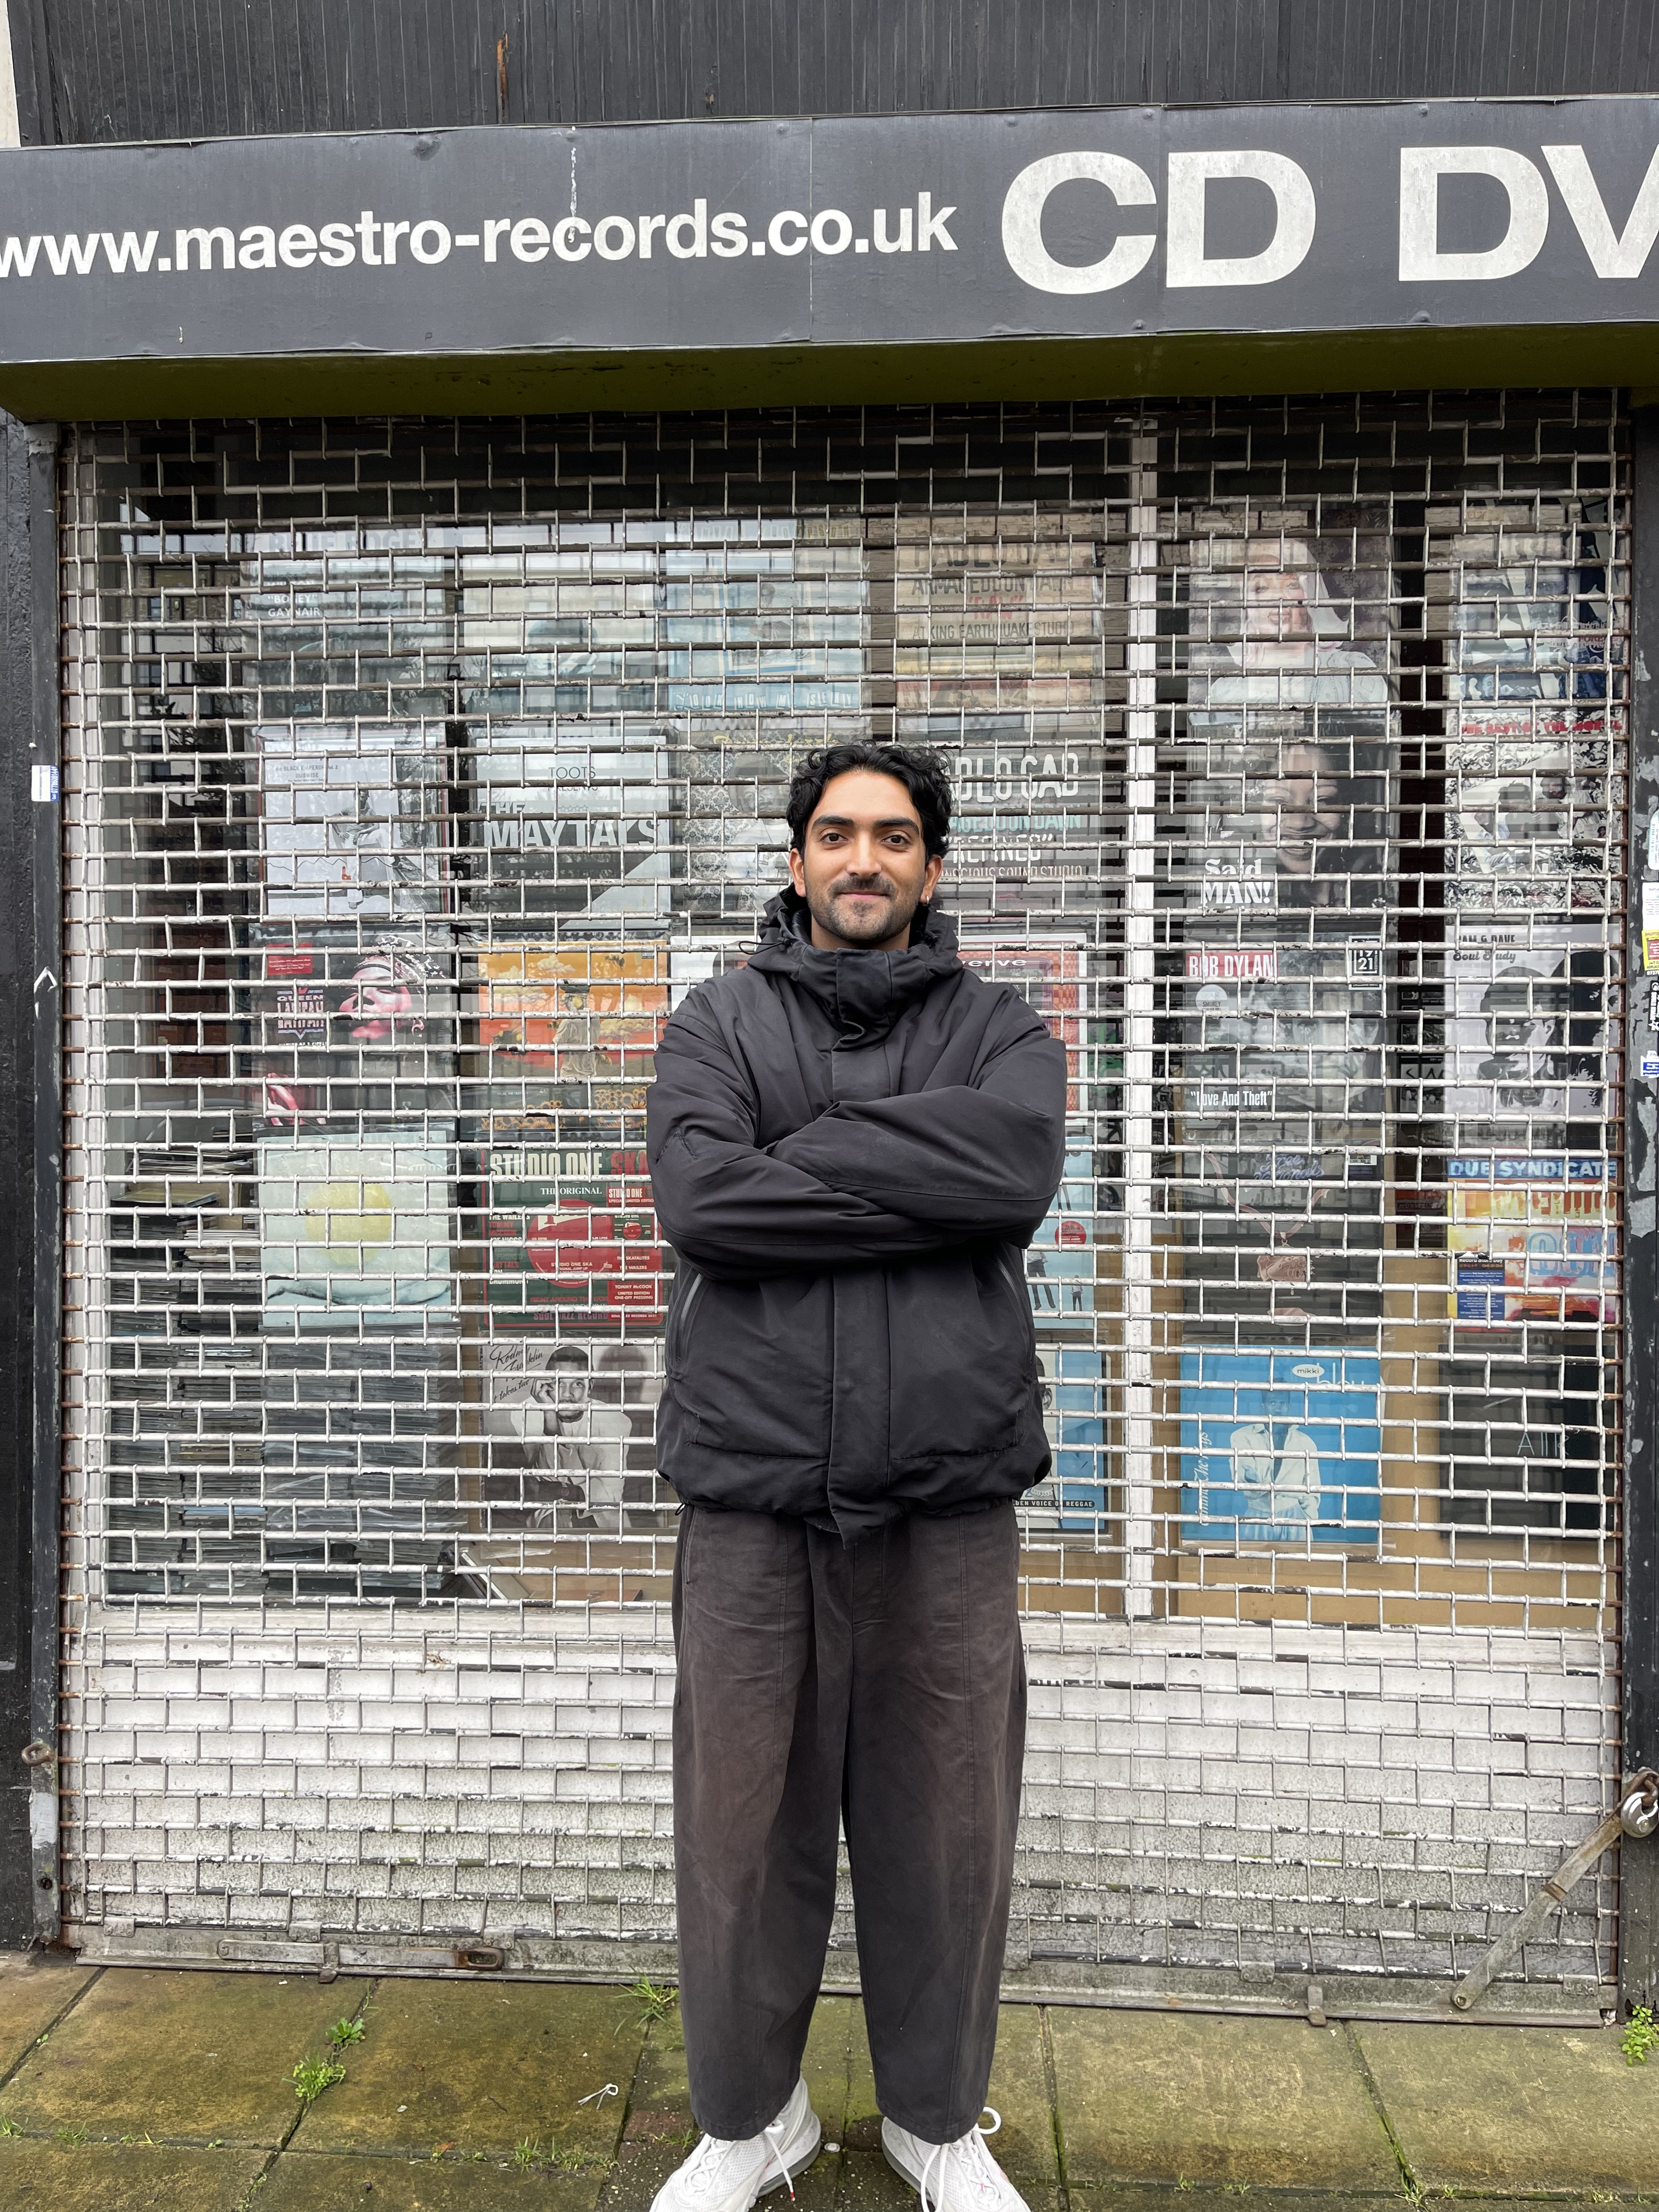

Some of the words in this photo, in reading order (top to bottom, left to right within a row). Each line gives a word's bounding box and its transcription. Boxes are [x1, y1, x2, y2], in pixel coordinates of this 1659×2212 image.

[1002, 151, 1316, 294] CD
[0, 191, 959, 279] www.maestro-records.co.uk
[947, 757, 1012, 803] BLO
[1020, 752, 1079, 800] GAD
[1200, 882, 1271, 904] MAN!
[1358, 957, 1373, 970] 21
[1482, 950, 1516, 964] Sudy
[1189, 955, 1218, 977] BOB
[1224, 954, 1273, 977] DYLAN
[276, 995, 324, 1003] QUEEN
[1222, 1091, 1240, 1106] And
[490, 1153, 561, 1176] STUDIO
[566, 1152, 602, 1175] ONE
[611, 1152, 650, 1175] SKA
[1498, 1160, 1617, 1177] SYNDICATE
[560, 1187, 602, 1195] ORIGINAL
[608, 1188, 630, 1198] STUO
[631, 1188, 642, 1198] ONE
[500, 1385, 520, 1401] takes
